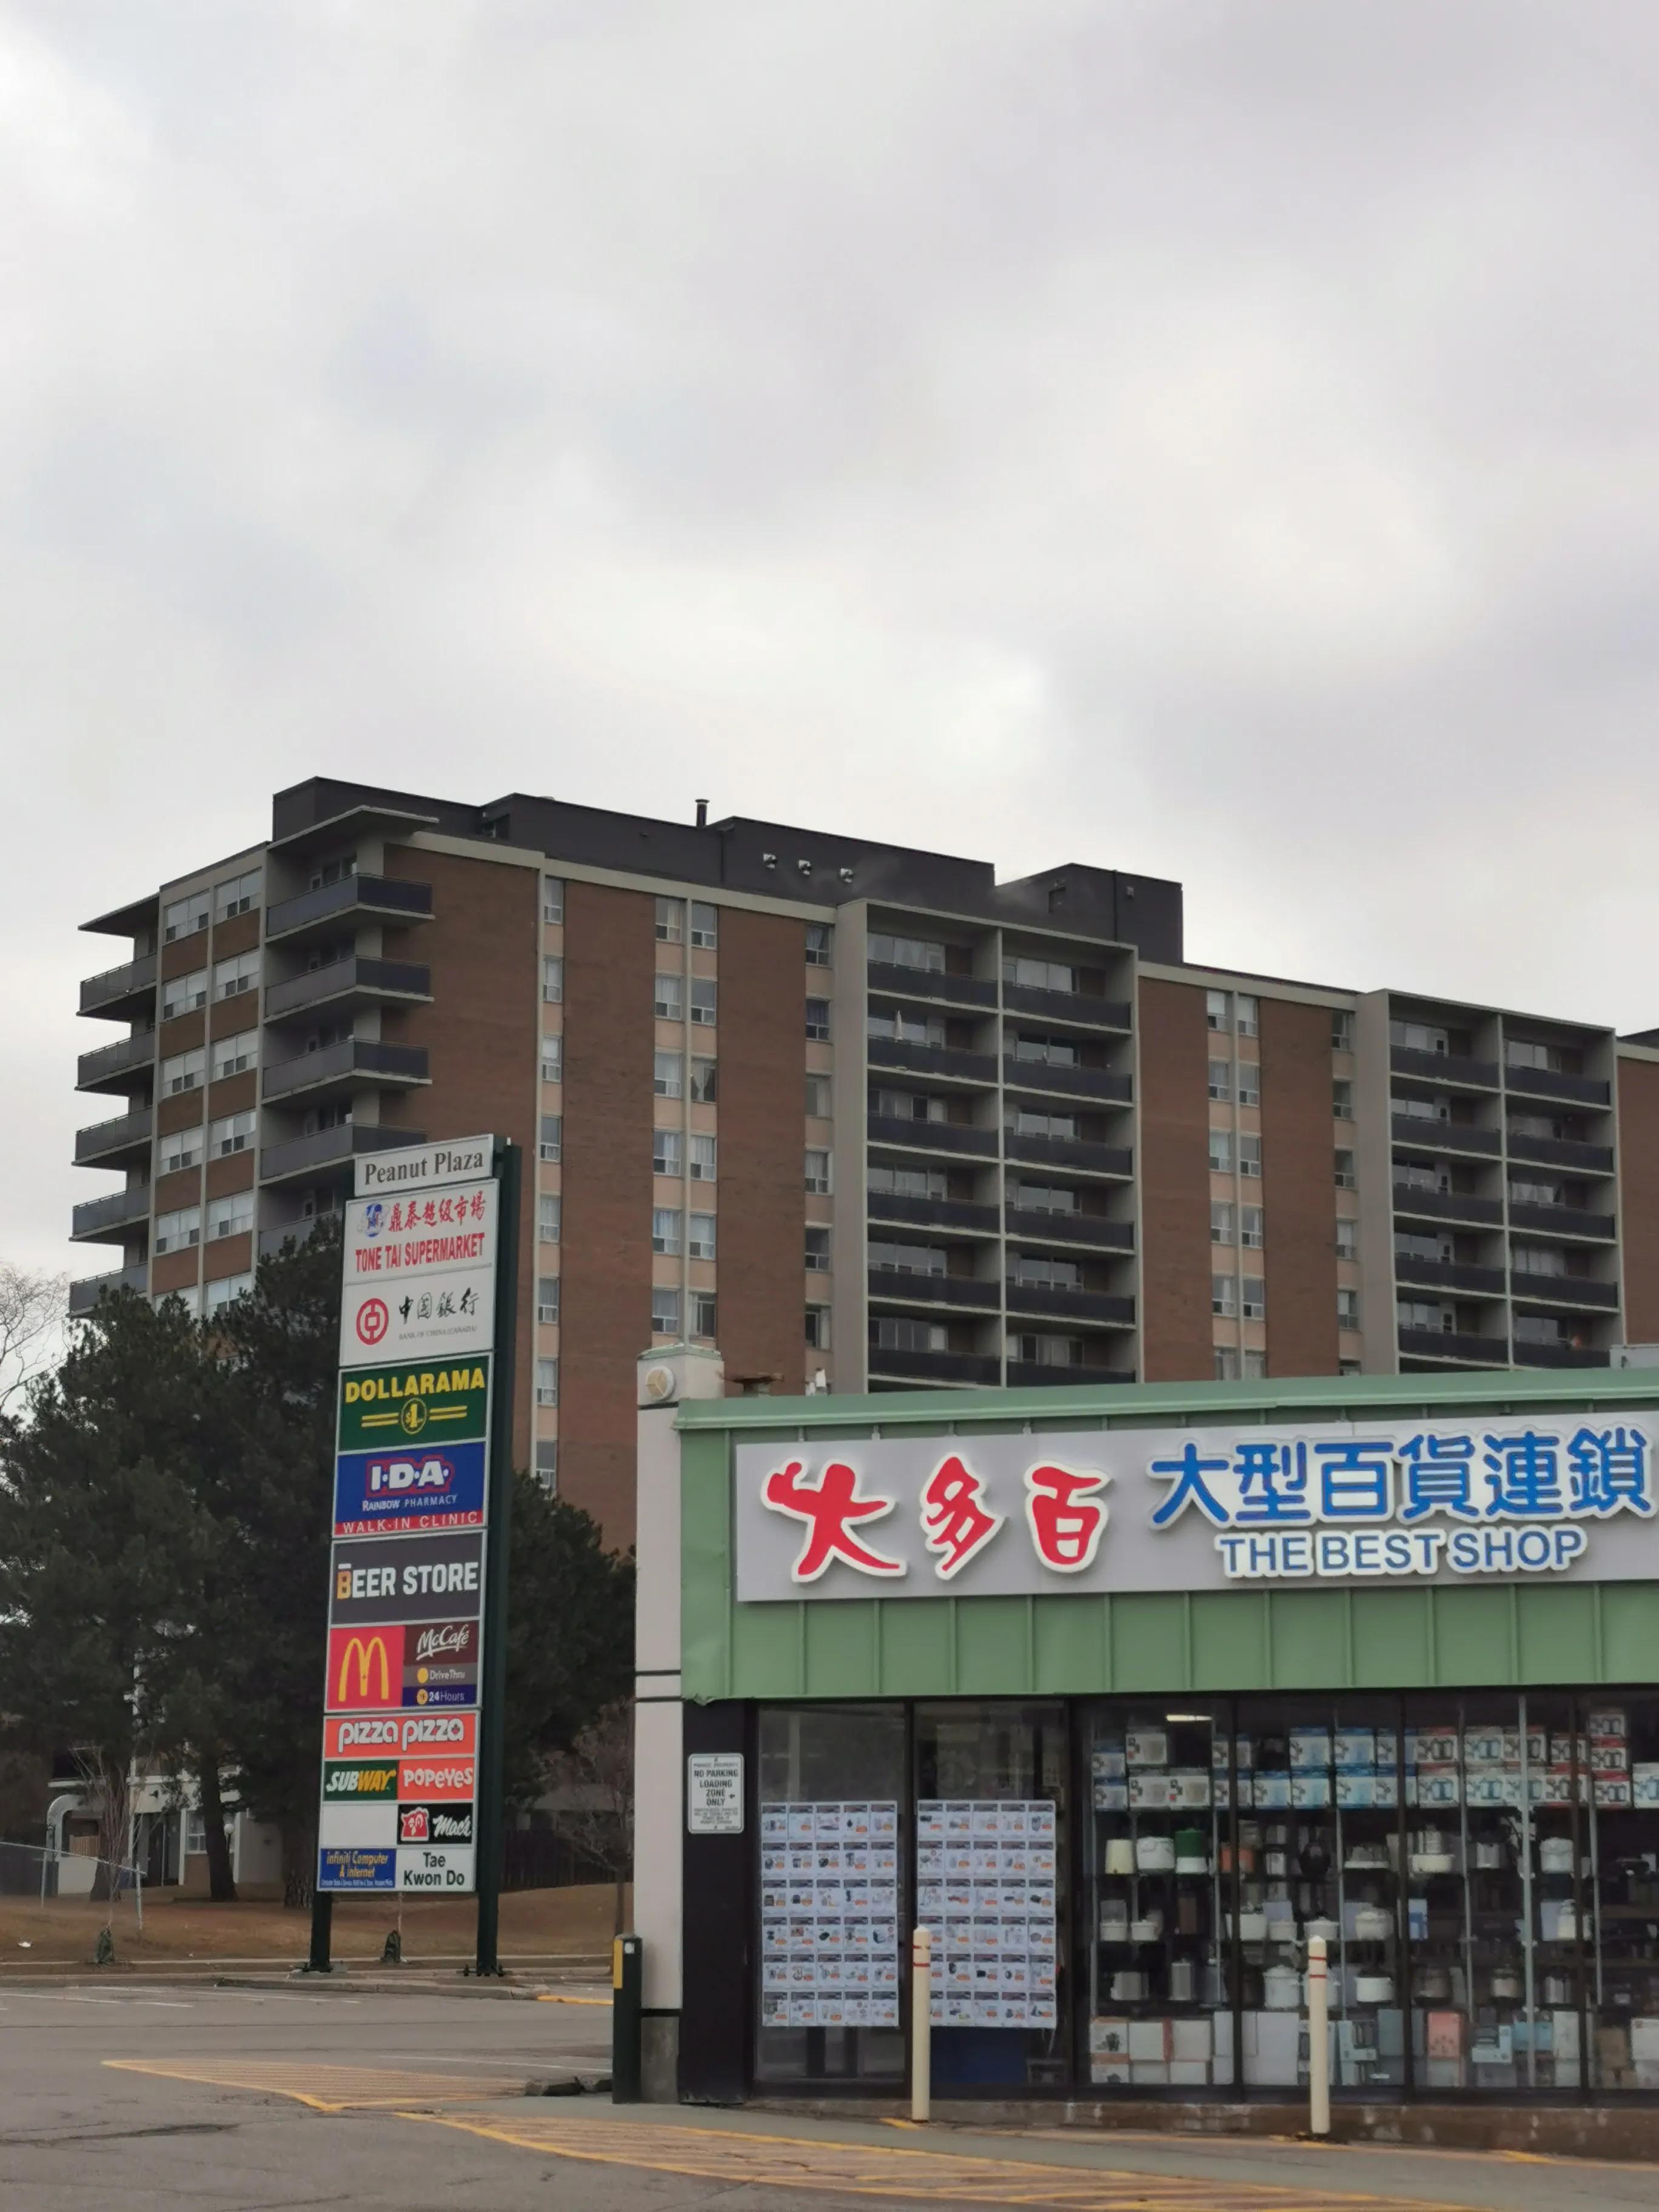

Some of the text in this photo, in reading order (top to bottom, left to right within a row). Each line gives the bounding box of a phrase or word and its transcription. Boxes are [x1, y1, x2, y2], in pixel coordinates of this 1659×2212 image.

[364, 1151, 483, 1185] Peanut Plaza
[355, 1232, 484, 1272] TONE TAI SUPERMARKET
[346, 1367, 485, 1403] DOLLARAMA
[1151, 1427, 1651, 1524] 大型百貨連鎖
[404, 1494, 458, 1508] PHARMACY
[343, 1511, 478, 1534] WALK-IN CLINIC
[1219, 1529, 1580, 1572] THE BEST SHOP
[337, 1561, 478, 1599] BEER STORE
[417, 1624, 470, 1659] McCafé
[326, 1769, 397, 1792] SUBWAY
[700, 1780, 732, 1788] LOADING
[423, 1852, 446, 1868] Tae
[404, 1871, 441, 1886] Kwon
[446, 1871, 465, 1885] Do
